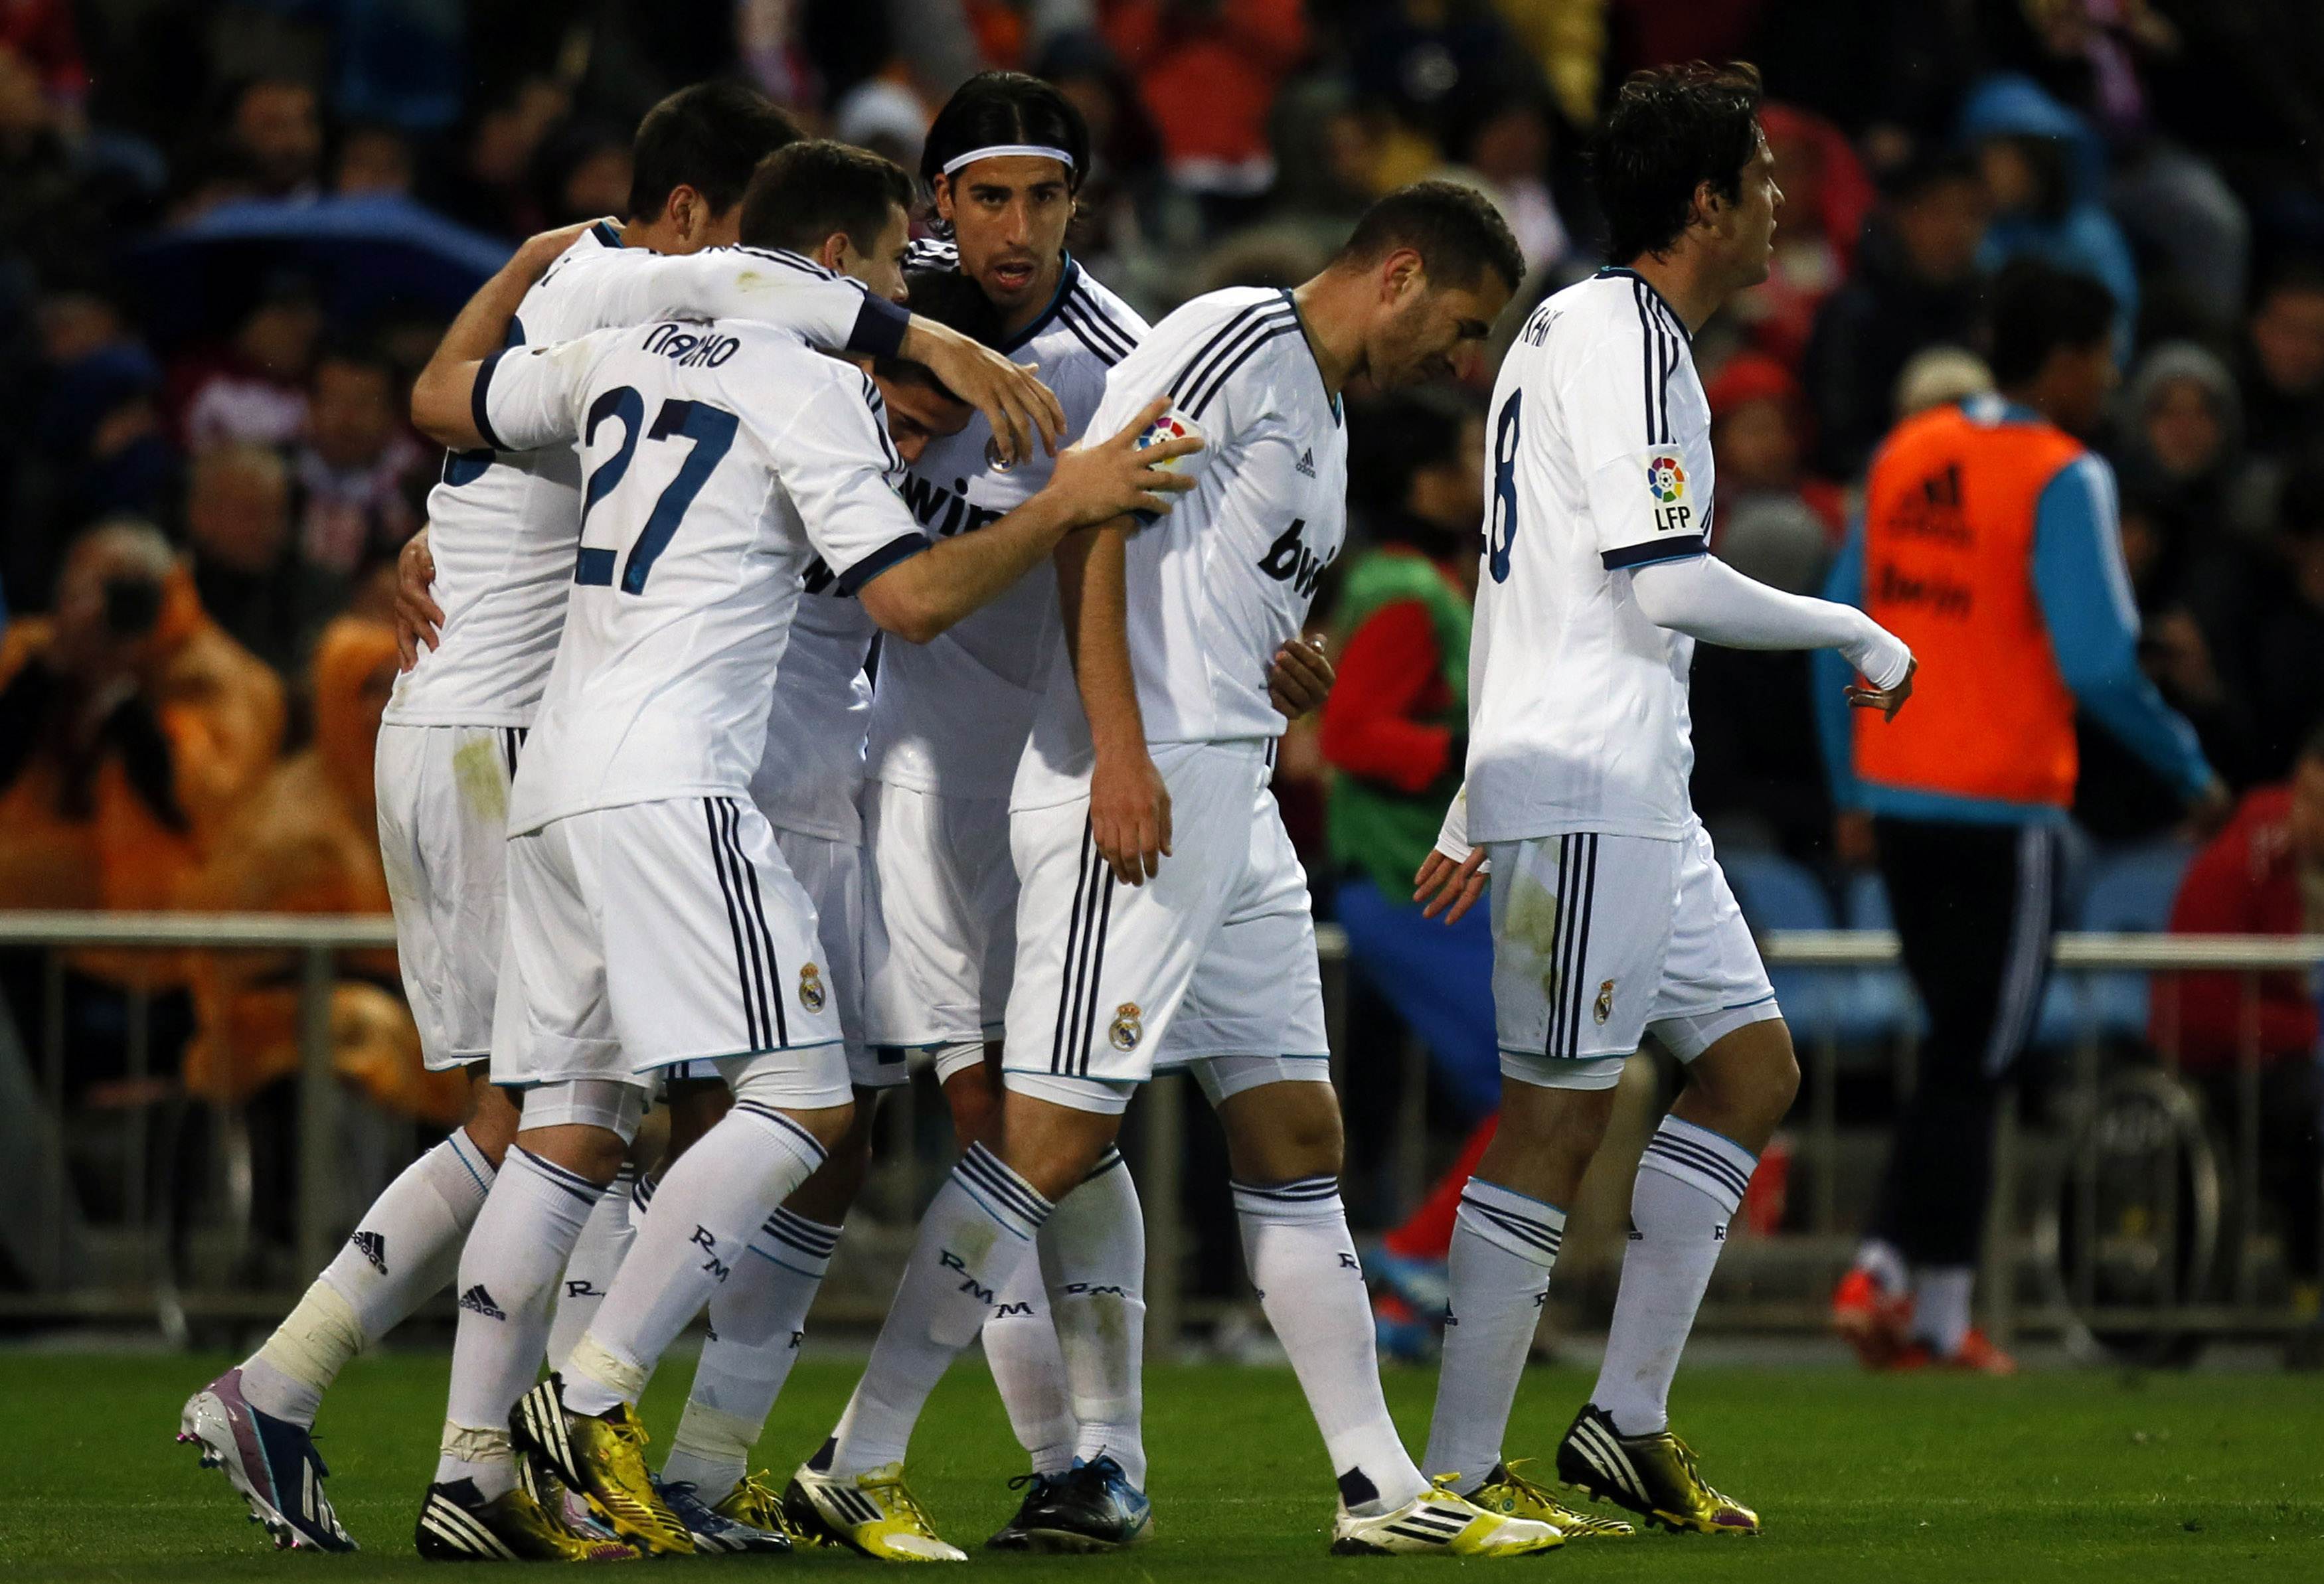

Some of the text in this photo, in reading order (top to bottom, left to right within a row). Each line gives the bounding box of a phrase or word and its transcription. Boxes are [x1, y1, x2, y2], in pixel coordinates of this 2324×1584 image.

[574, 386, 739, 595] 27
[1482, 387, 1522, 584] 8
[1655, 506, 1691, 531] LFP
[1258, 518, 1335, 599] bwi
[1714, 1226, 1726, 1240] R
[566, 1281, 606, 1298] R
[994, 1302, 1034, 1318] M
